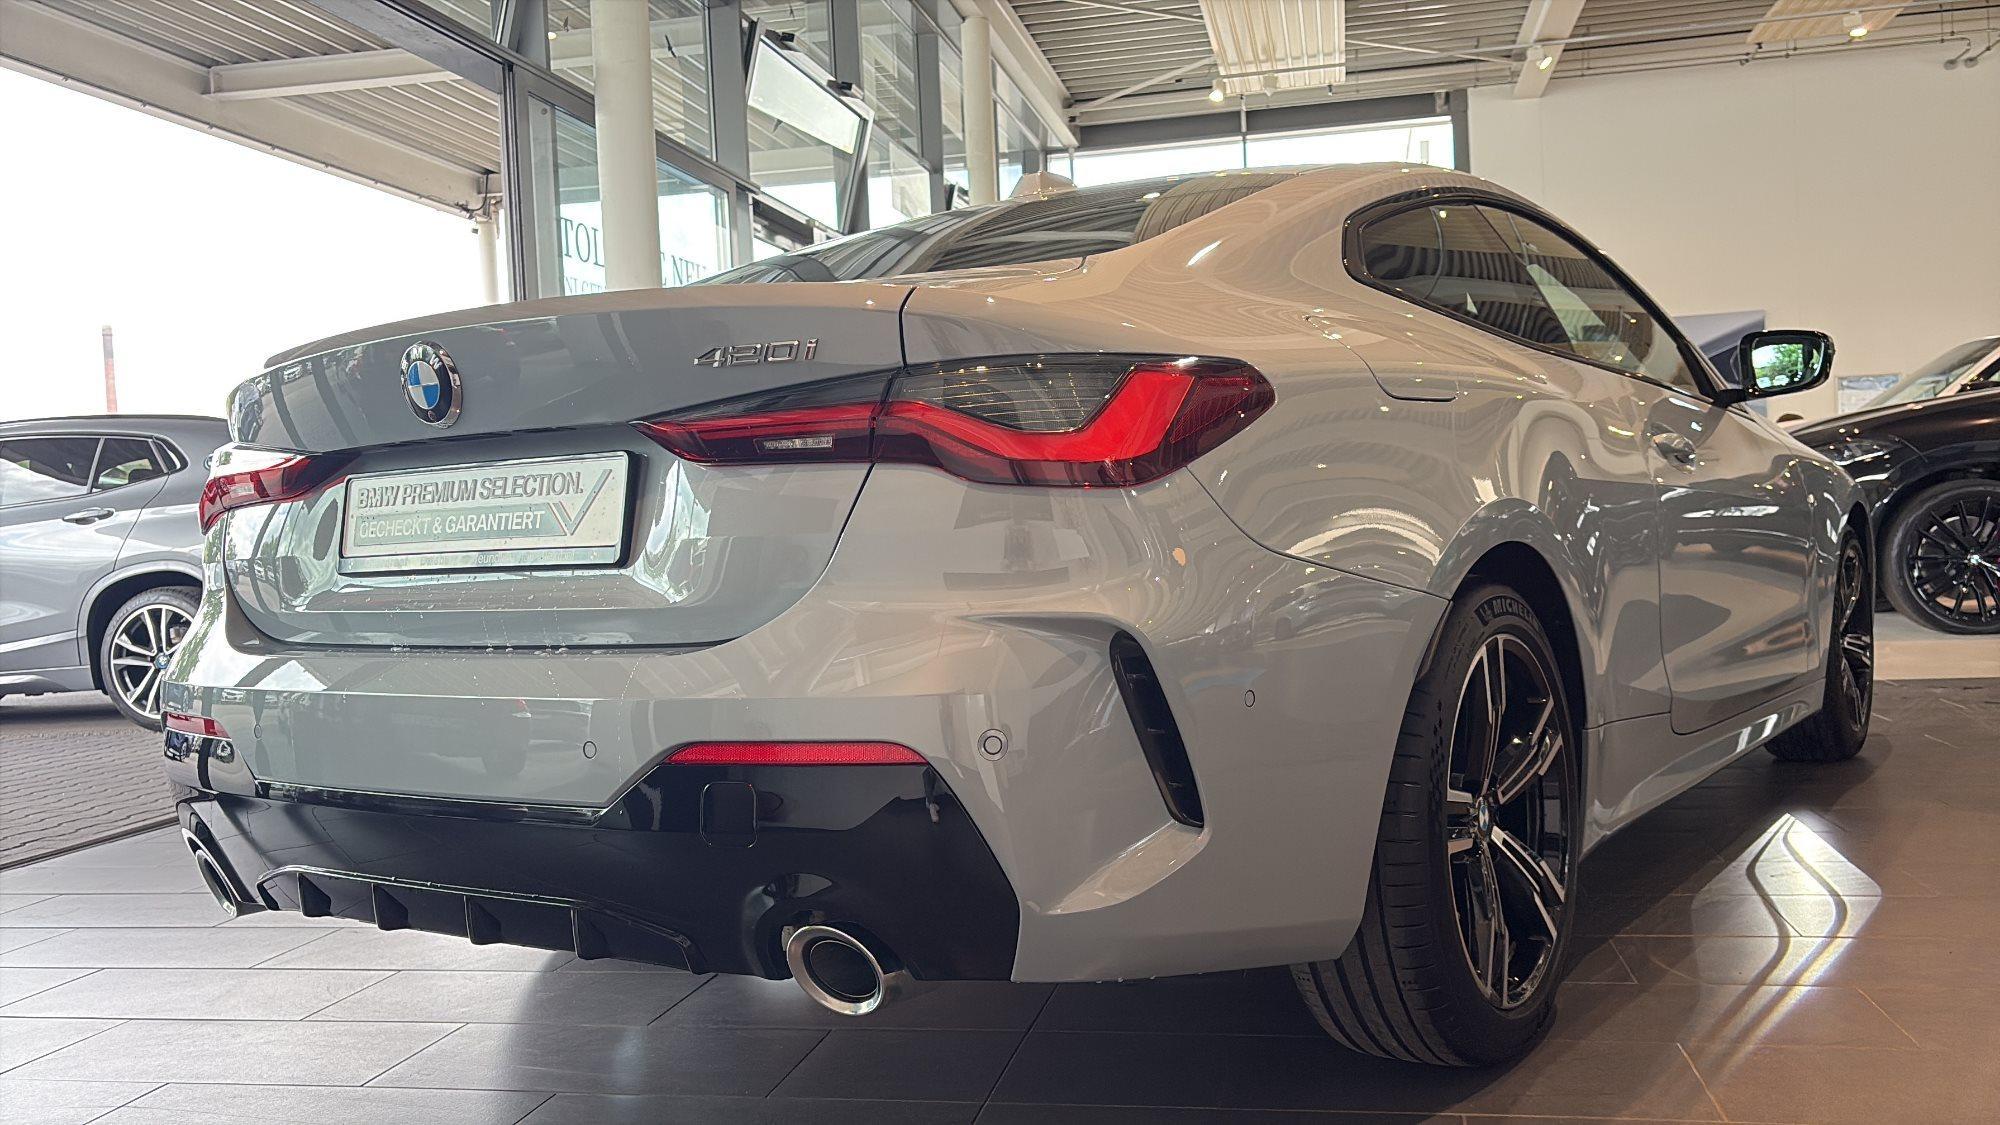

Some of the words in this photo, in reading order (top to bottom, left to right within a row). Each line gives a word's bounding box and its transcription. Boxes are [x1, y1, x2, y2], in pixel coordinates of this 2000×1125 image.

[694, 338, 819, 368] 420i
[358, 485, 400, 509] BMW
[400, 479, 478, 506] PREMIUM
[359, 517, 431, 539] GECHECKT
[432, 515, 442, 533] &
[445, 510, 546, 533] GARANTIERT
